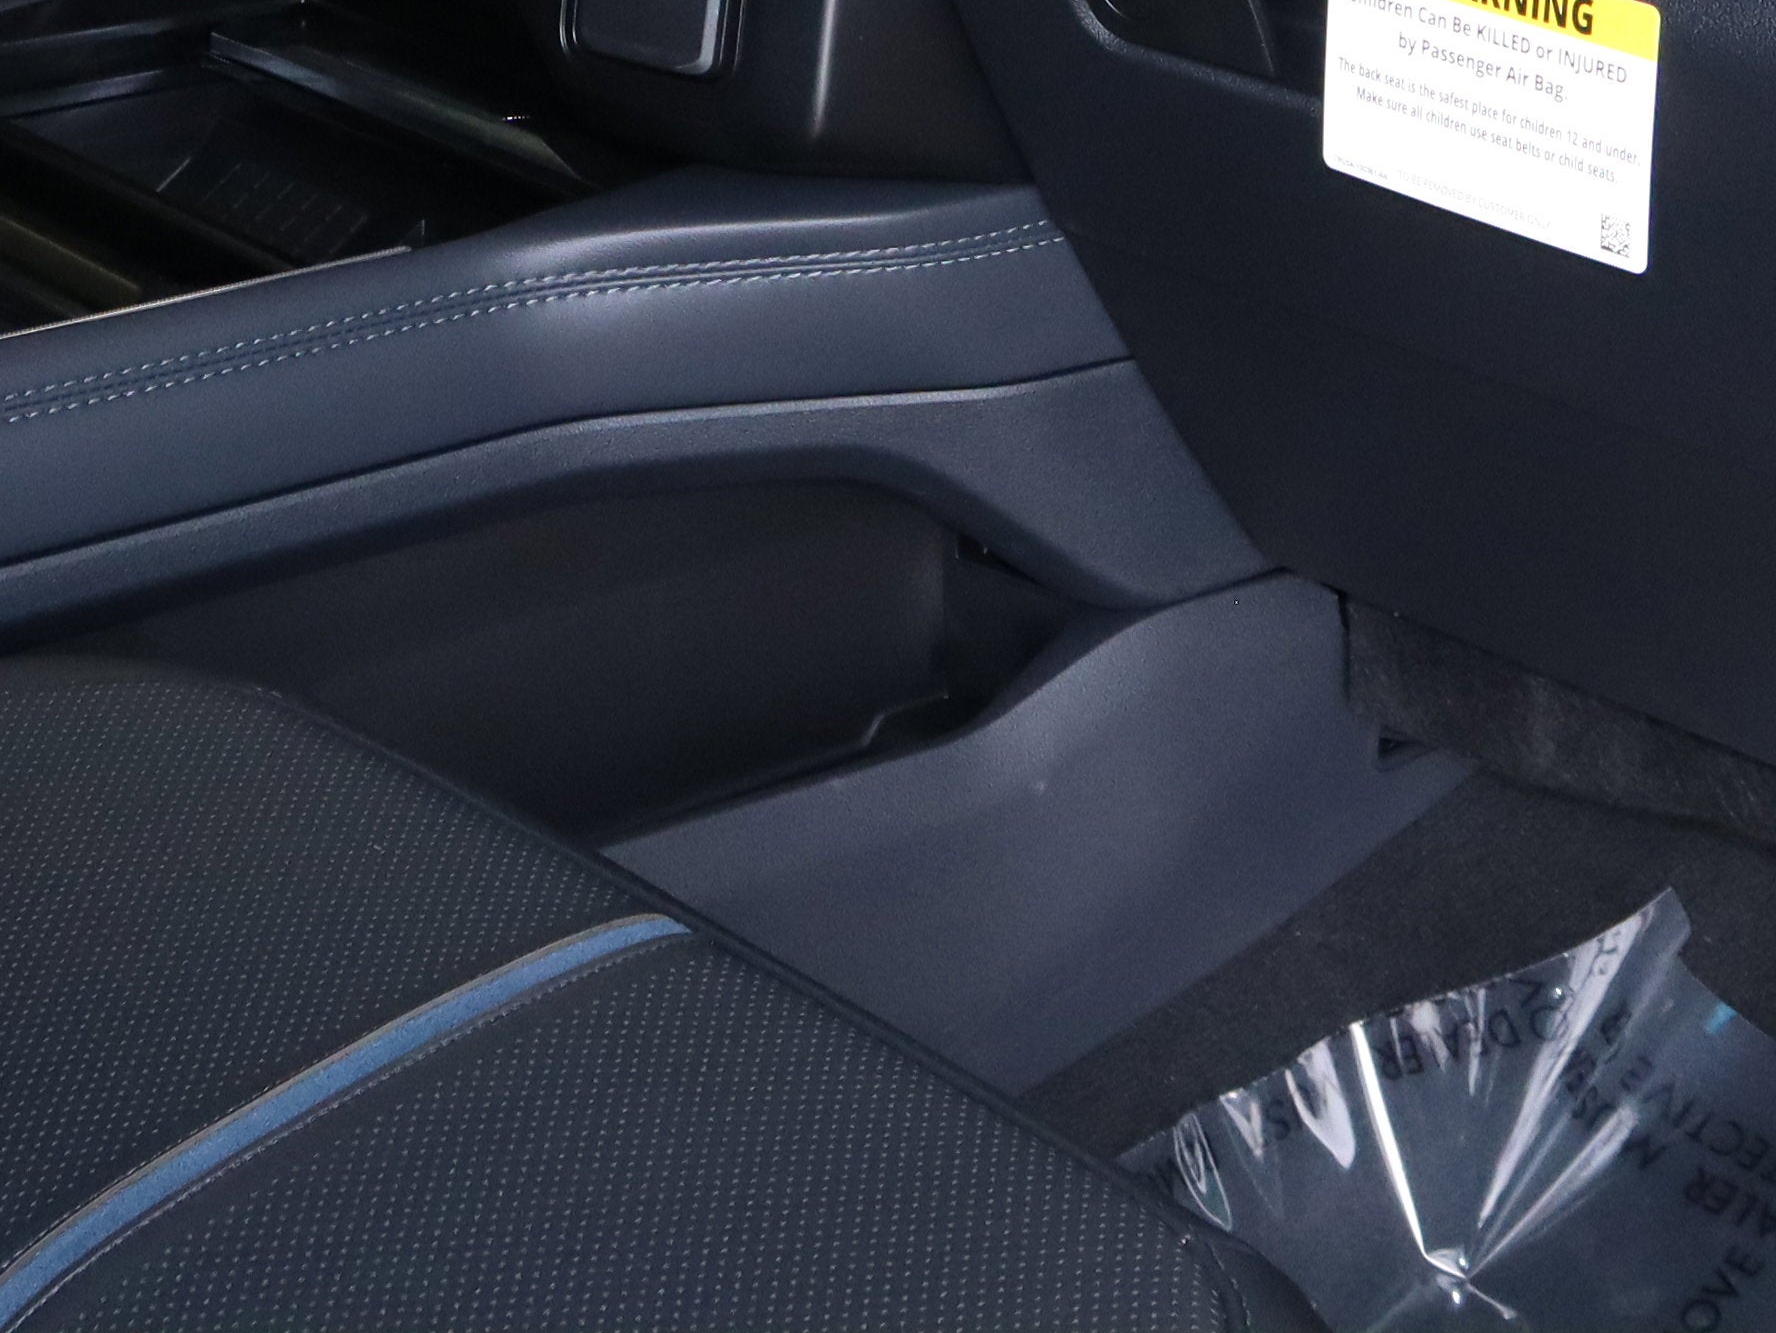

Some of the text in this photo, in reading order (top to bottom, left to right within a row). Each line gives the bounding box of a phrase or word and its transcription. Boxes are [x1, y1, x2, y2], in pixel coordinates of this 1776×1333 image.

[1398, 31, 1417, 57] by
[1421, 38, 1502, 79] Passenger
[1505, 66, 1529, 86] Air
[1418, 6, 1447, 30] Can
[1452, 16, 1472, 37] Be
[1476, 24, 1531, 54] KILLED
[1535, 45, 1553, 61] or
[1558, 48, 1628, 84] INJURED
[1338, 56, 1356, 75] The
[1358, 62, 1382, 82] back
[1384, 74, 1405, 91] seat
[1407, 82, 1416, 94] is
[1419, 83, 1436, 100] the
[1438, 91, 1469, 111] safest
[1471, 101, 1499, 121] place
[1501, 108, 1518, 125] for
[1519, 116, 1562, 140] children
[1567, 129, 1578, 147] 12
[1581, 137, 1602, 154] and
[1356, 85, 1383, 107] Make
[1386, 98, 1408, 115] sure
[1410, 105, 1423, 120] all
[1425, 110, 1467, 135] children
[1469, 126, 1488, 142] use
[1490, 132, 1513, 150] seat
[1516, 137, 1541, 158] belts
[1544, 150, 1556, 163] or
[1558, 153, 1584, 173] child
[1672, 1244, 1765, 1333] OVE
